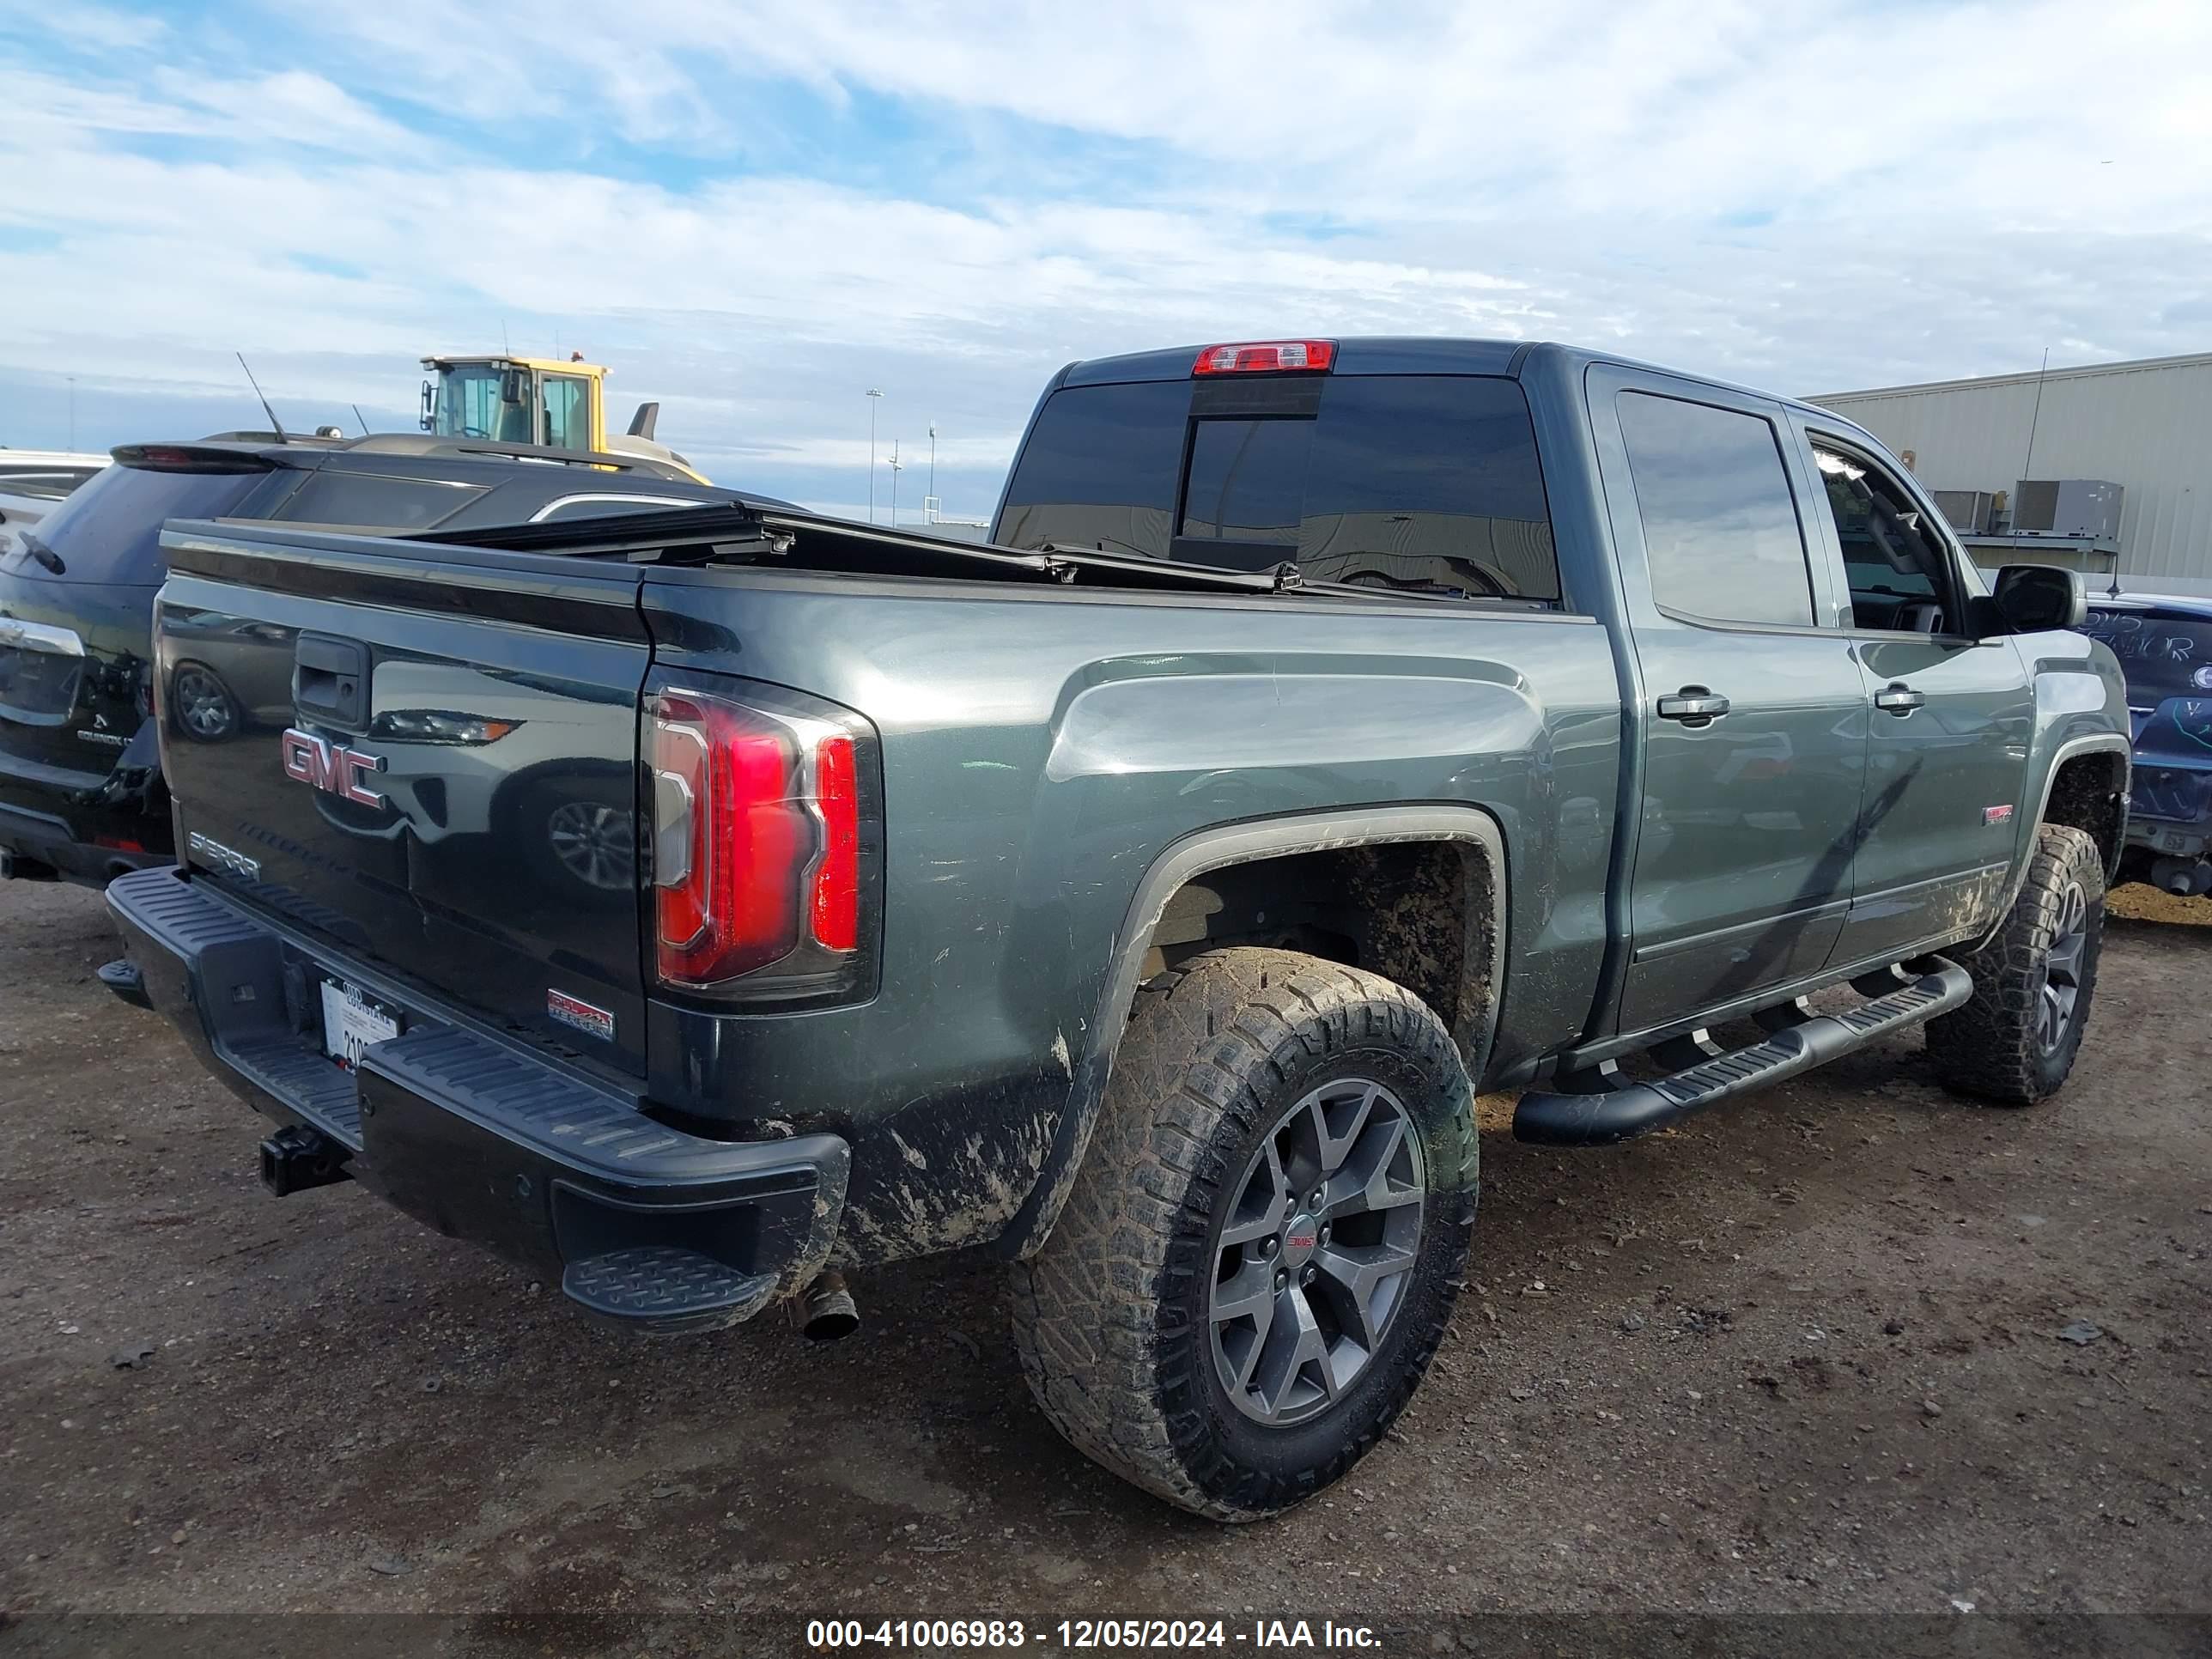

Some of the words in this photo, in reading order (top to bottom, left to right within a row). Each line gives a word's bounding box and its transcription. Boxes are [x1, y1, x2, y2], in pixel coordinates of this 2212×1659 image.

[282, 727, 388, 811] GMC
[189, 831, 261, 883] SIERRA
[346, 995, 392, 1028] LOUISIANA
